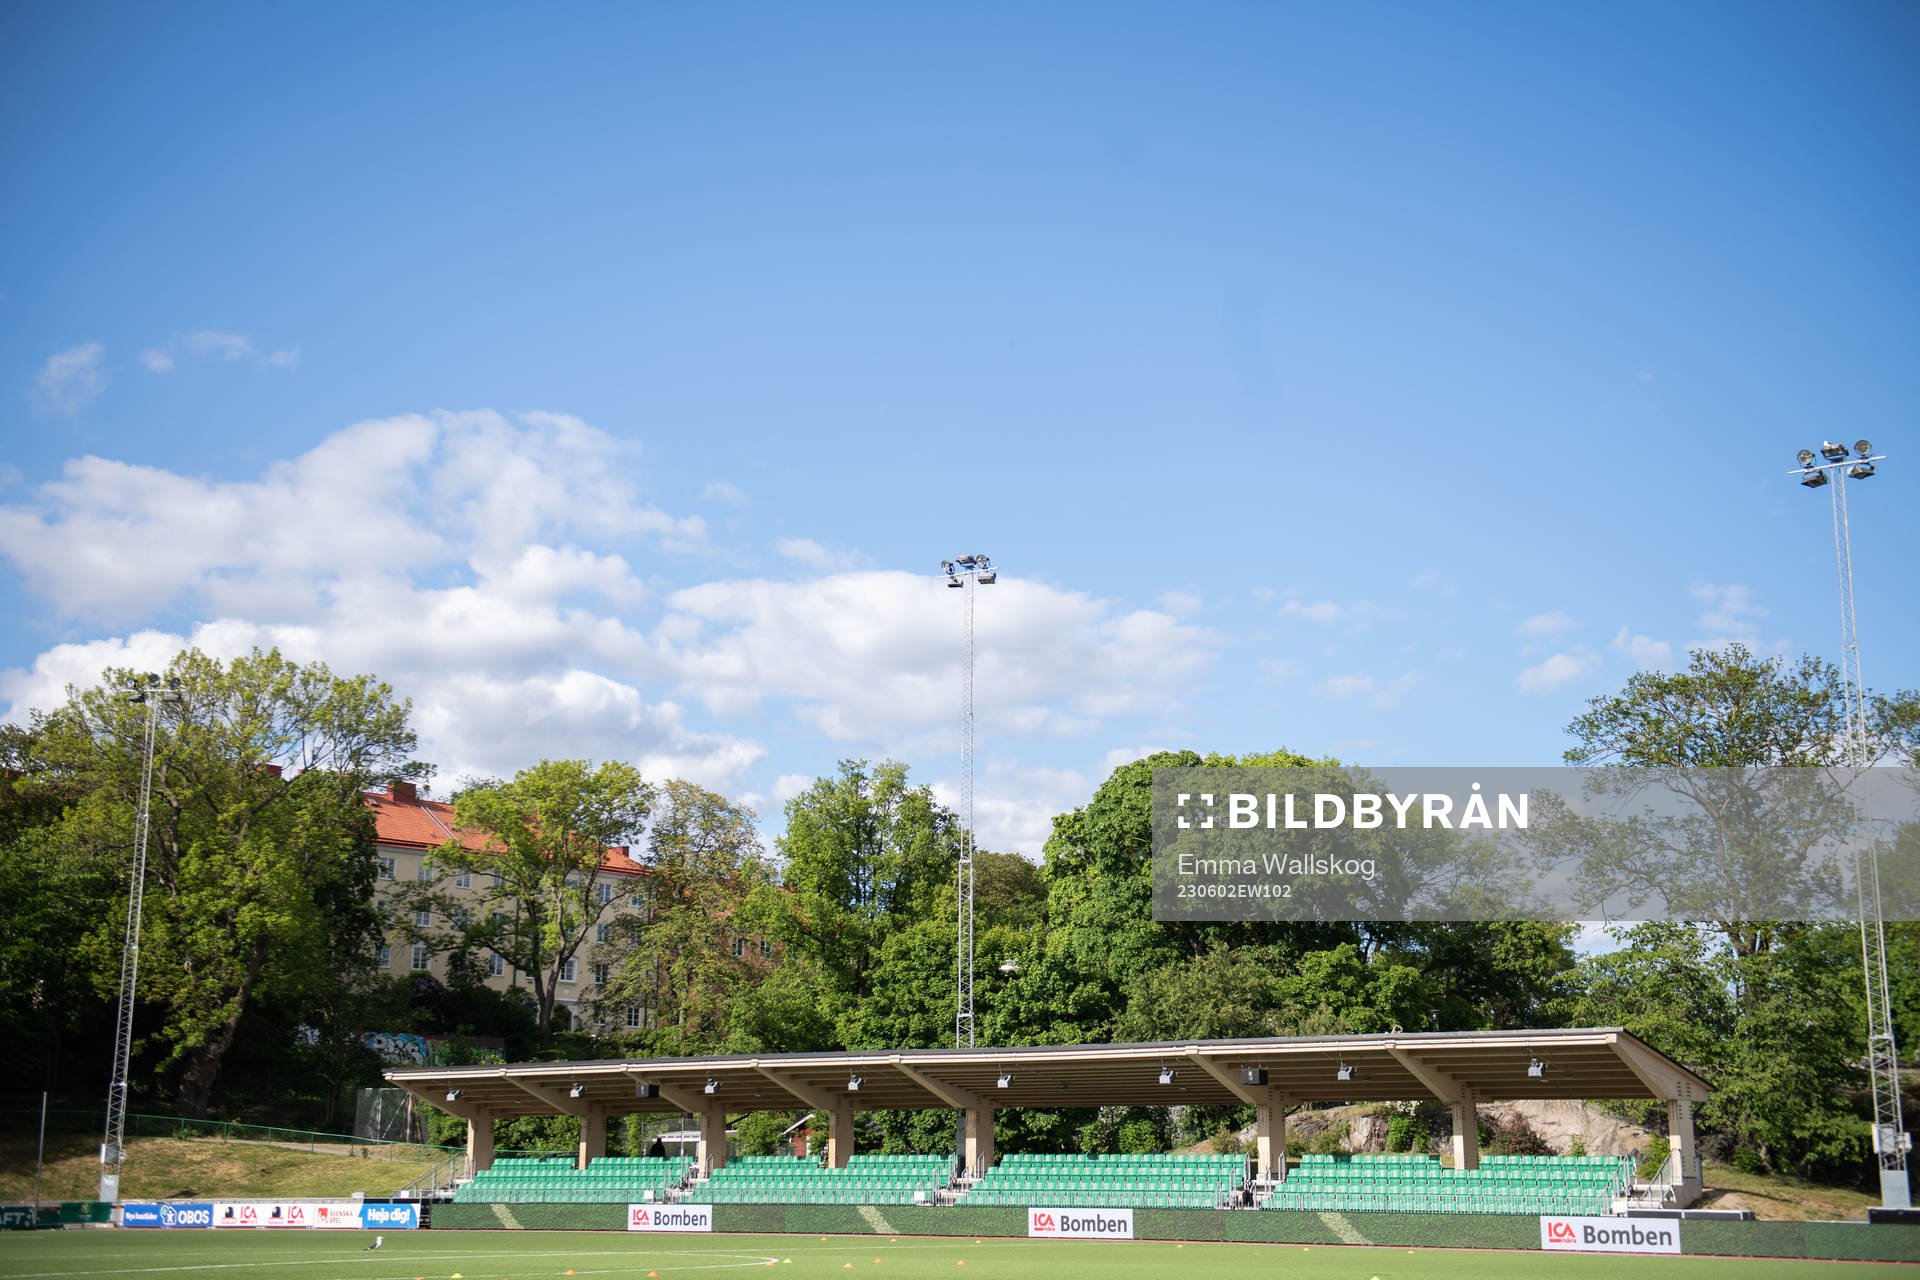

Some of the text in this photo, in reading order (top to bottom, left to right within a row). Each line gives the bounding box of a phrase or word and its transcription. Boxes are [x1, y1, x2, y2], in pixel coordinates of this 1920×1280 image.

[178, 1210, 210, 1224] OBOS
[240, 1206, 257, 1219] ICA
[287, 1206, 304, 1219] ICA
[367, 1207, 411, 1223] Heja dig!
[633, 1209, 649, 1221] ICA
[654, 1210, 707, 1226] Bomben
[1034, 1213, 1055, 1226] ICA
[1060, 1214, 1128, 1232] Bomben
[1548, 1222, 1576, 1238] ICA
[1583, 1224, 1672, 1246] Bomben
